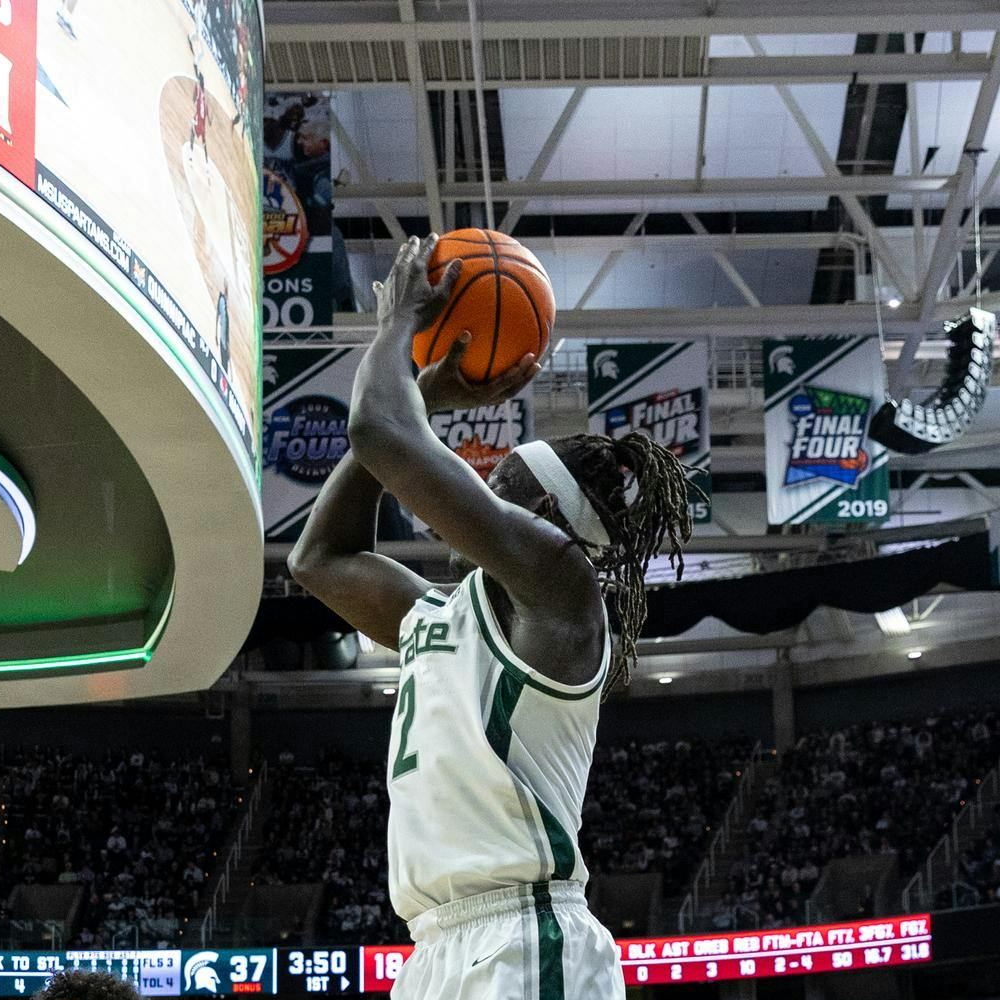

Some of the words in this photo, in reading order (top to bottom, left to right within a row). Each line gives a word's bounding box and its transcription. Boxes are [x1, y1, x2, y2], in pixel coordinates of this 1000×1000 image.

[452, 400, 523, 422] FINAL
[631, 393, 697, 428] FINAL
[292, 416, 347, 437] FINAL
[430, 414, 523, 450] FOUR
[796, 414, 863, 438] FINAL
[267, 431, 348, 462] FOUR
[791, 436, 860, 460] FOUR
[837, 499, 889, 518] 2019
[11, 956, 30, 972] TO
[37, 956, 65, 972] STL
[143, 957, 164, 968] FLS
[167, 957, 174, 968] 3
[229, 954, 267, 983] 37
[288, 950, 347, 975] 3:50
[374, 952, 404, 980] 18
[14, 978, 25, 994] 4
[142, 977, 164, 988] TOL
[166, 977, 174, 988] 4
[306, 976, 330, 992] 1ST
